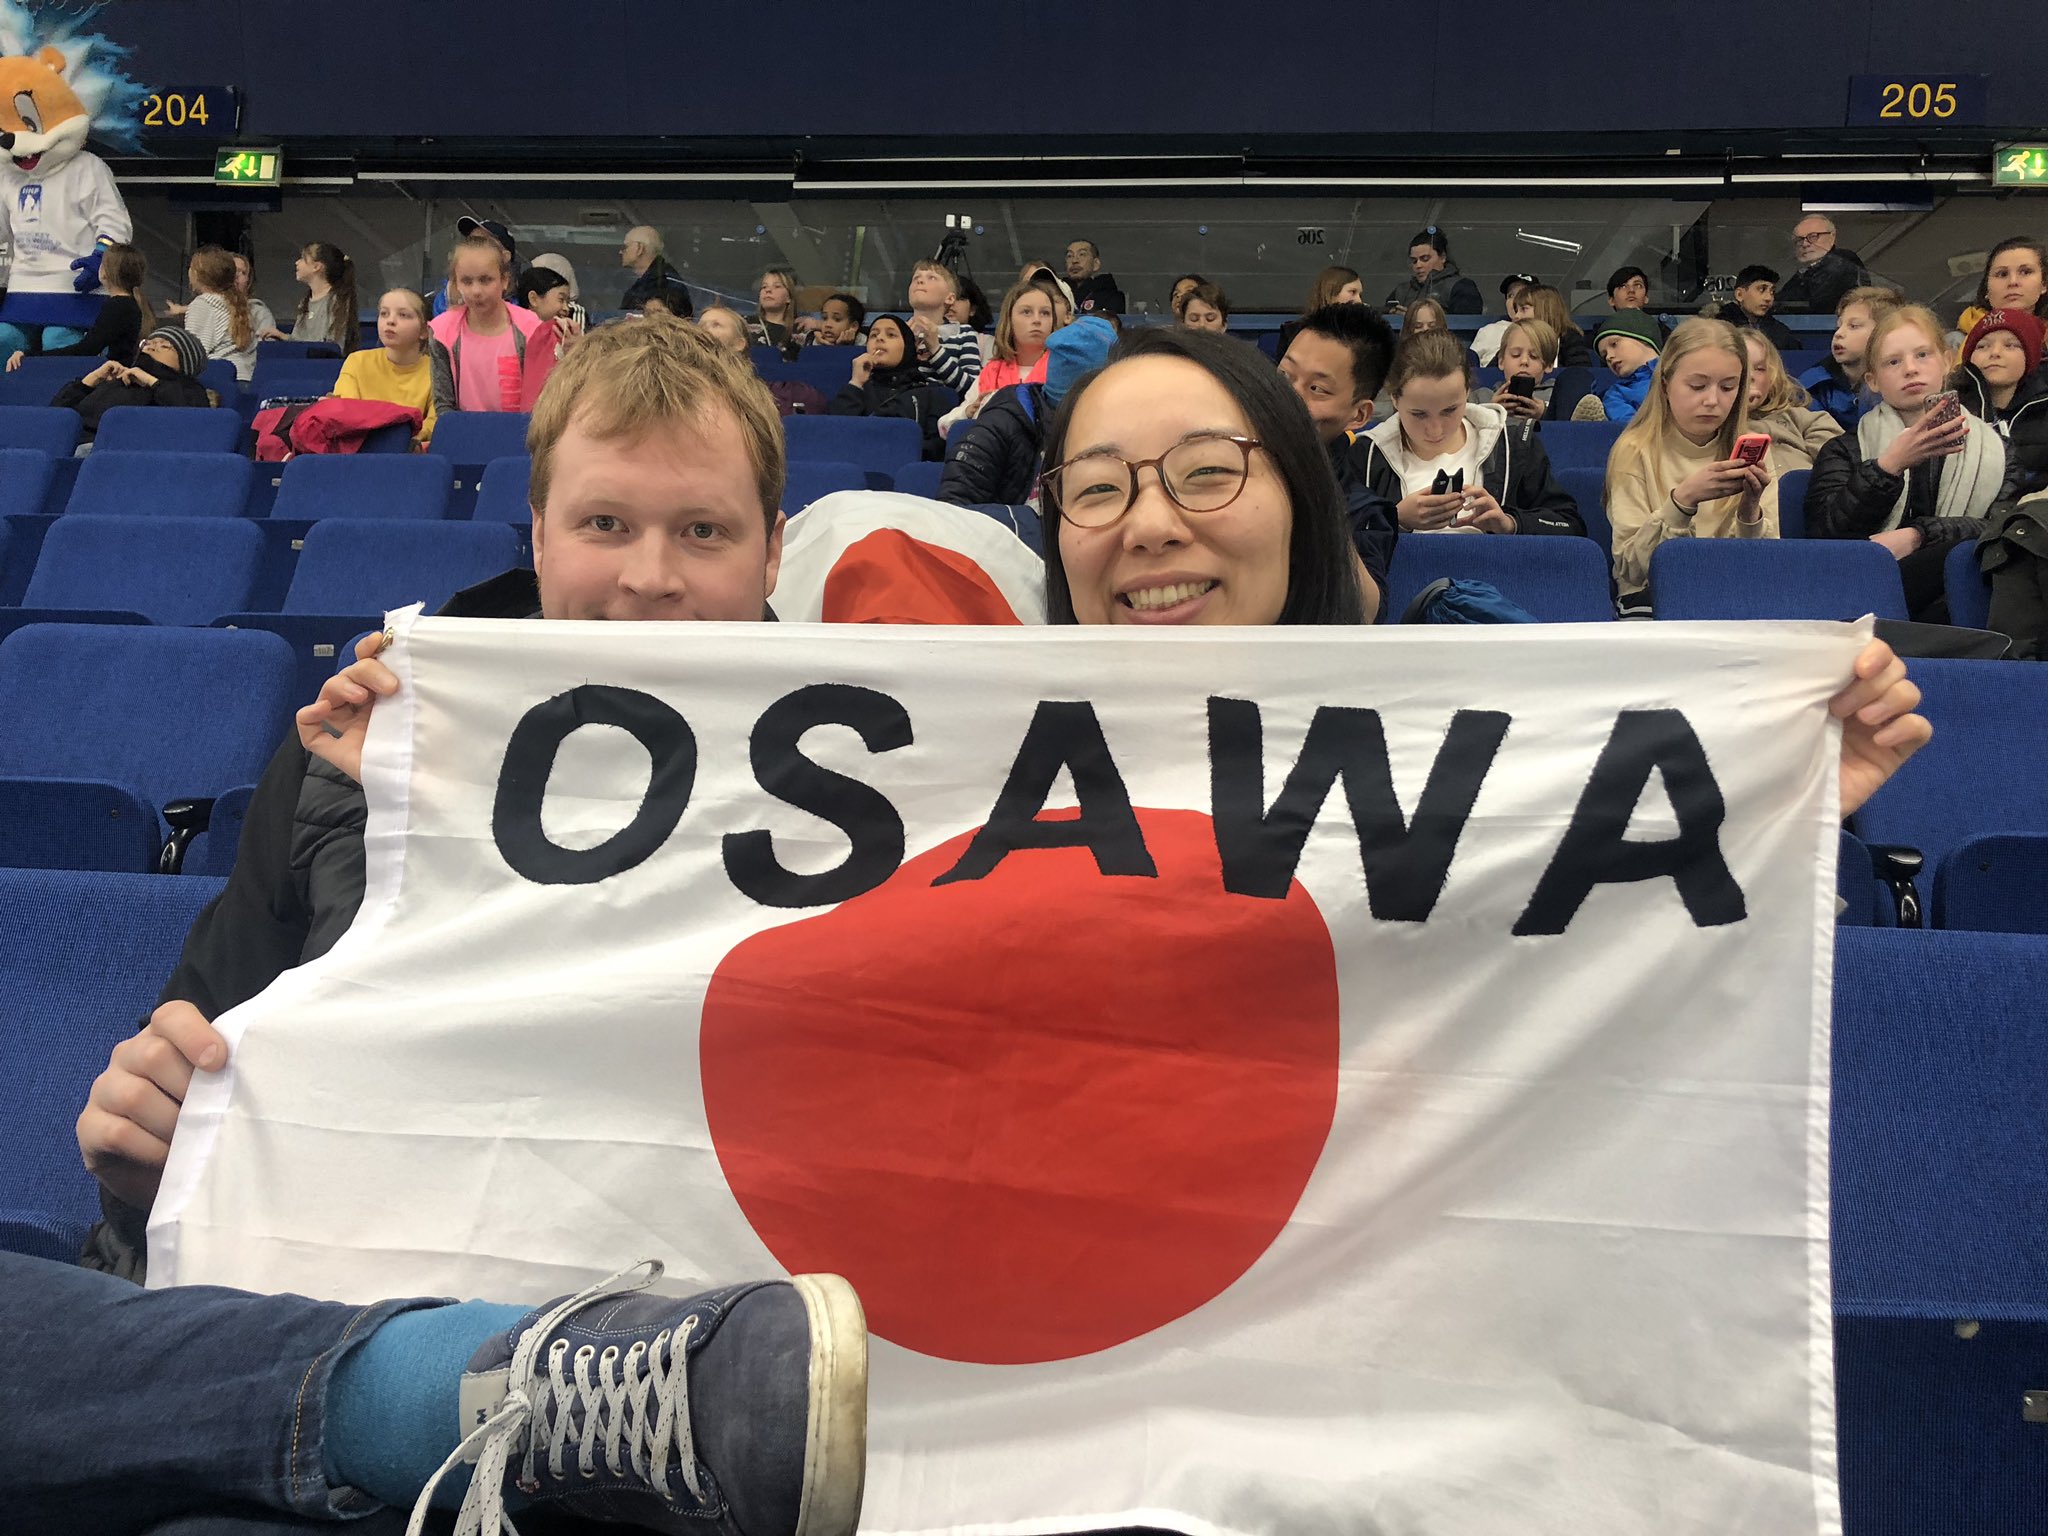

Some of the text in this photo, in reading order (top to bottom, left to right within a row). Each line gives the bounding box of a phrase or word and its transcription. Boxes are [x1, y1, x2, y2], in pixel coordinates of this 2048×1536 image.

[143, 94, 209, 126] 204
[1880, 83, 1957, 117] 205
[493, 683, 1747, 936] OSAWA
